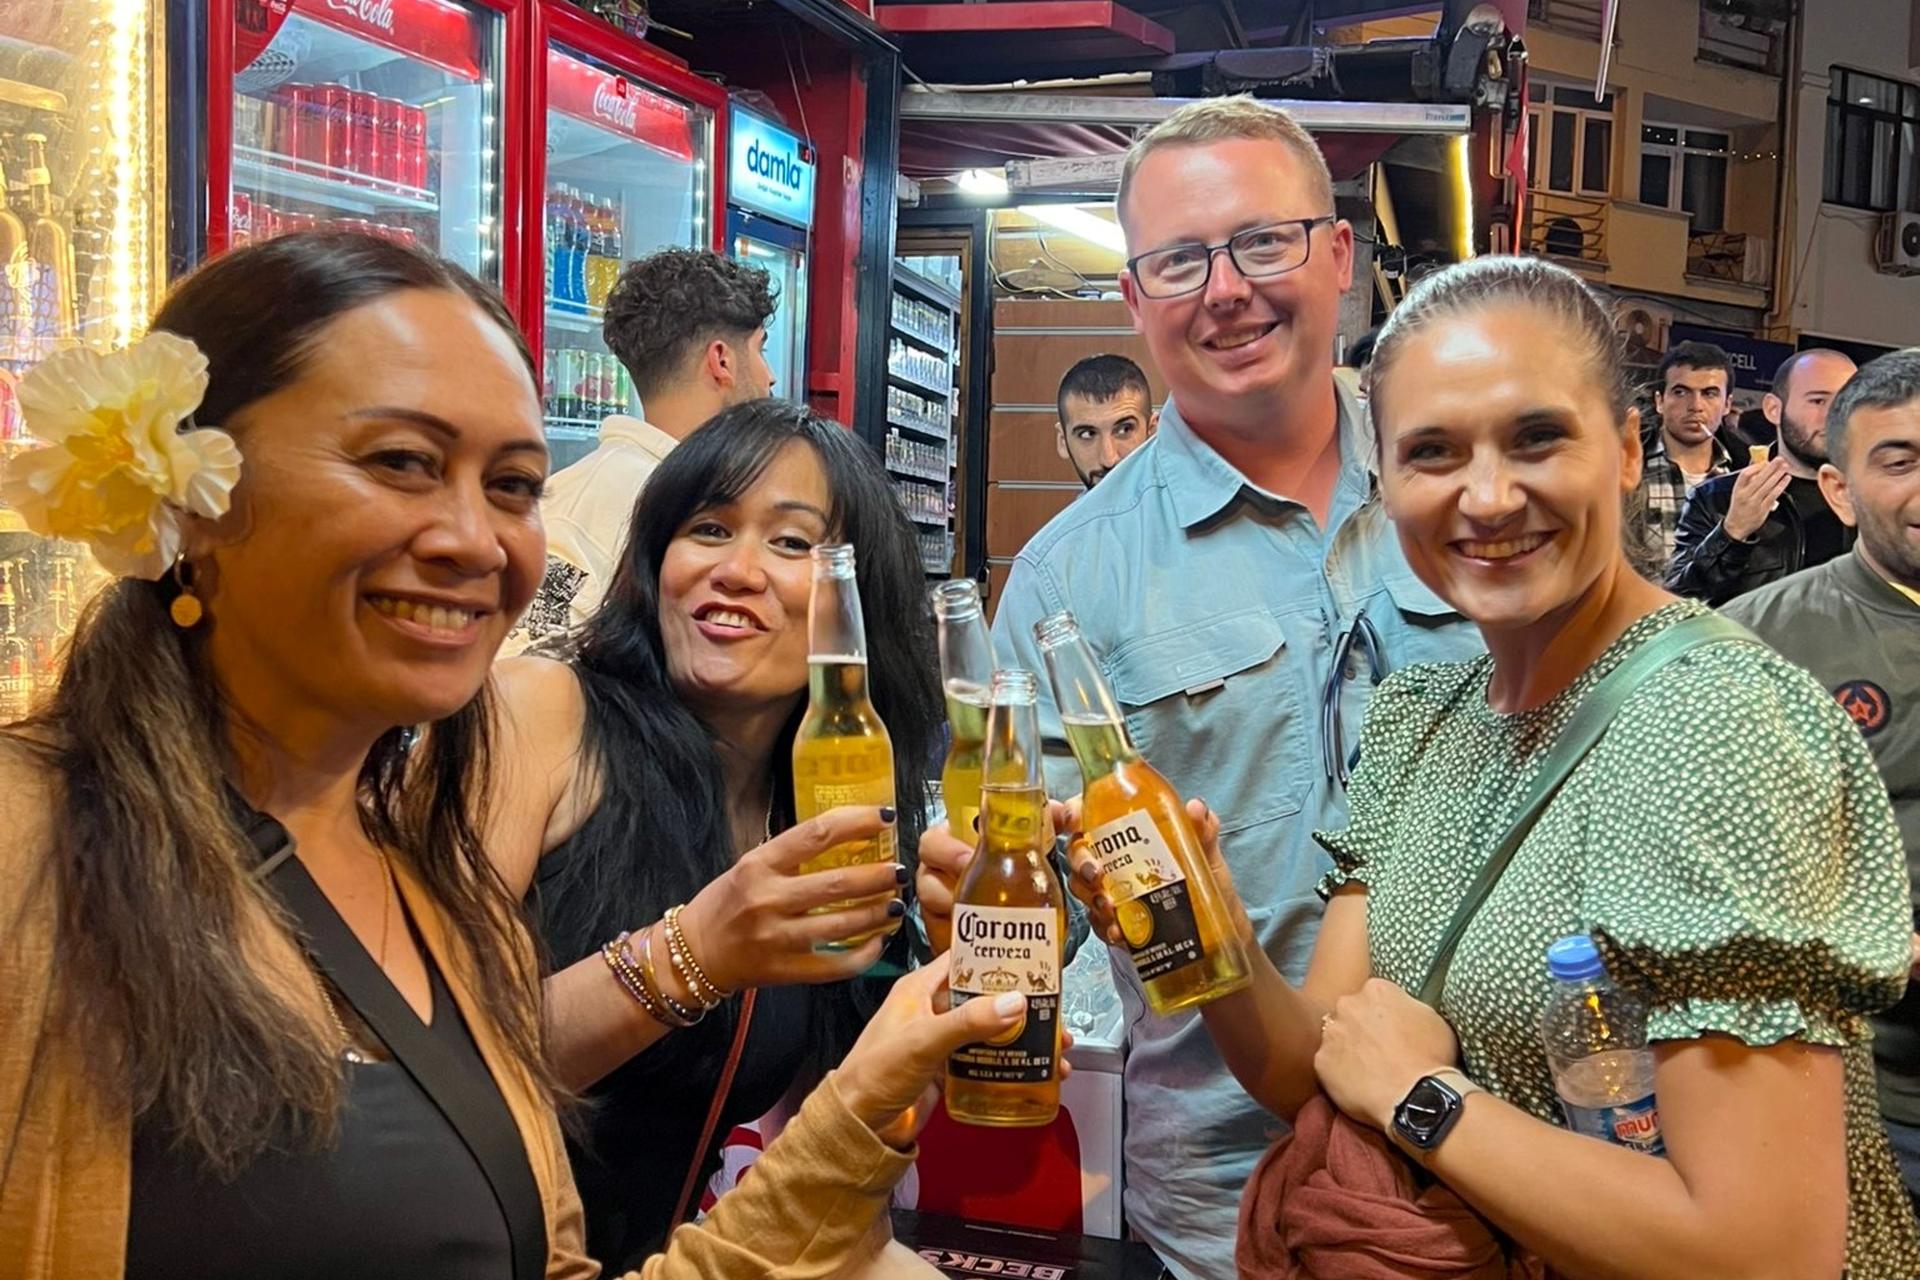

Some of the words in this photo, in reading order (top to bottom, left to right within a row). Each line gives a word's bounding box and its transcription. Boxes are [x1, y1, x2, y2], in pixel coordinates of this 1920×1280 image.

[747, 138, 801, 190] damla
[1090, 826, 1143, 860] rona
[1103, 853, 1133, 874] rveza
[957, 910, 1047, 947] Corona
[974, 944, 1031, 960] cerveza
